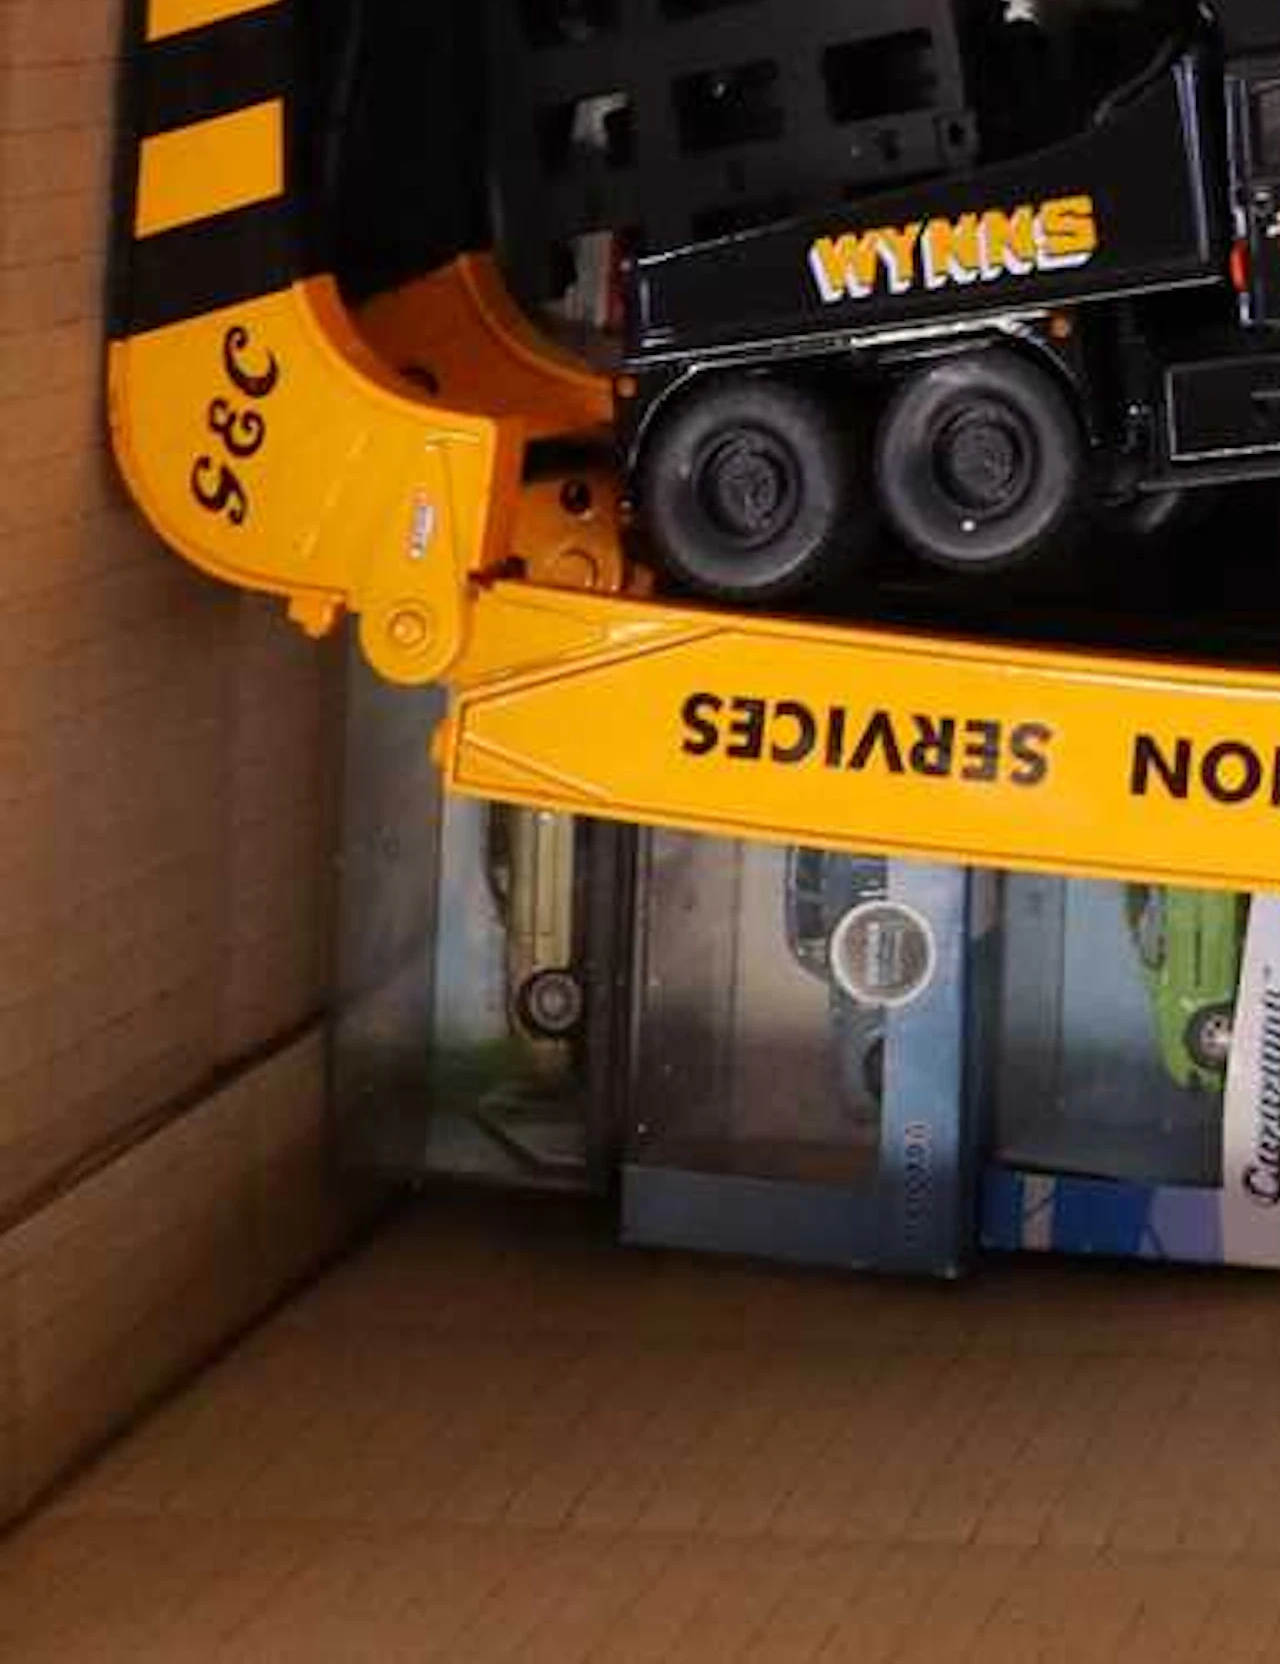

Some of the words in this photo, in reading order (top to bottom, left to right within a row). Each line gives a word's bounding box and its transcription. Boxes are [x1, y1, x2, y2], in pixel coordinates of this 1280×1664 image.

[808, 193, 1098, 304] WYNNS
[190, 325, 280, 527] GEC
[680, 691, 1052, 786] SERVICES
